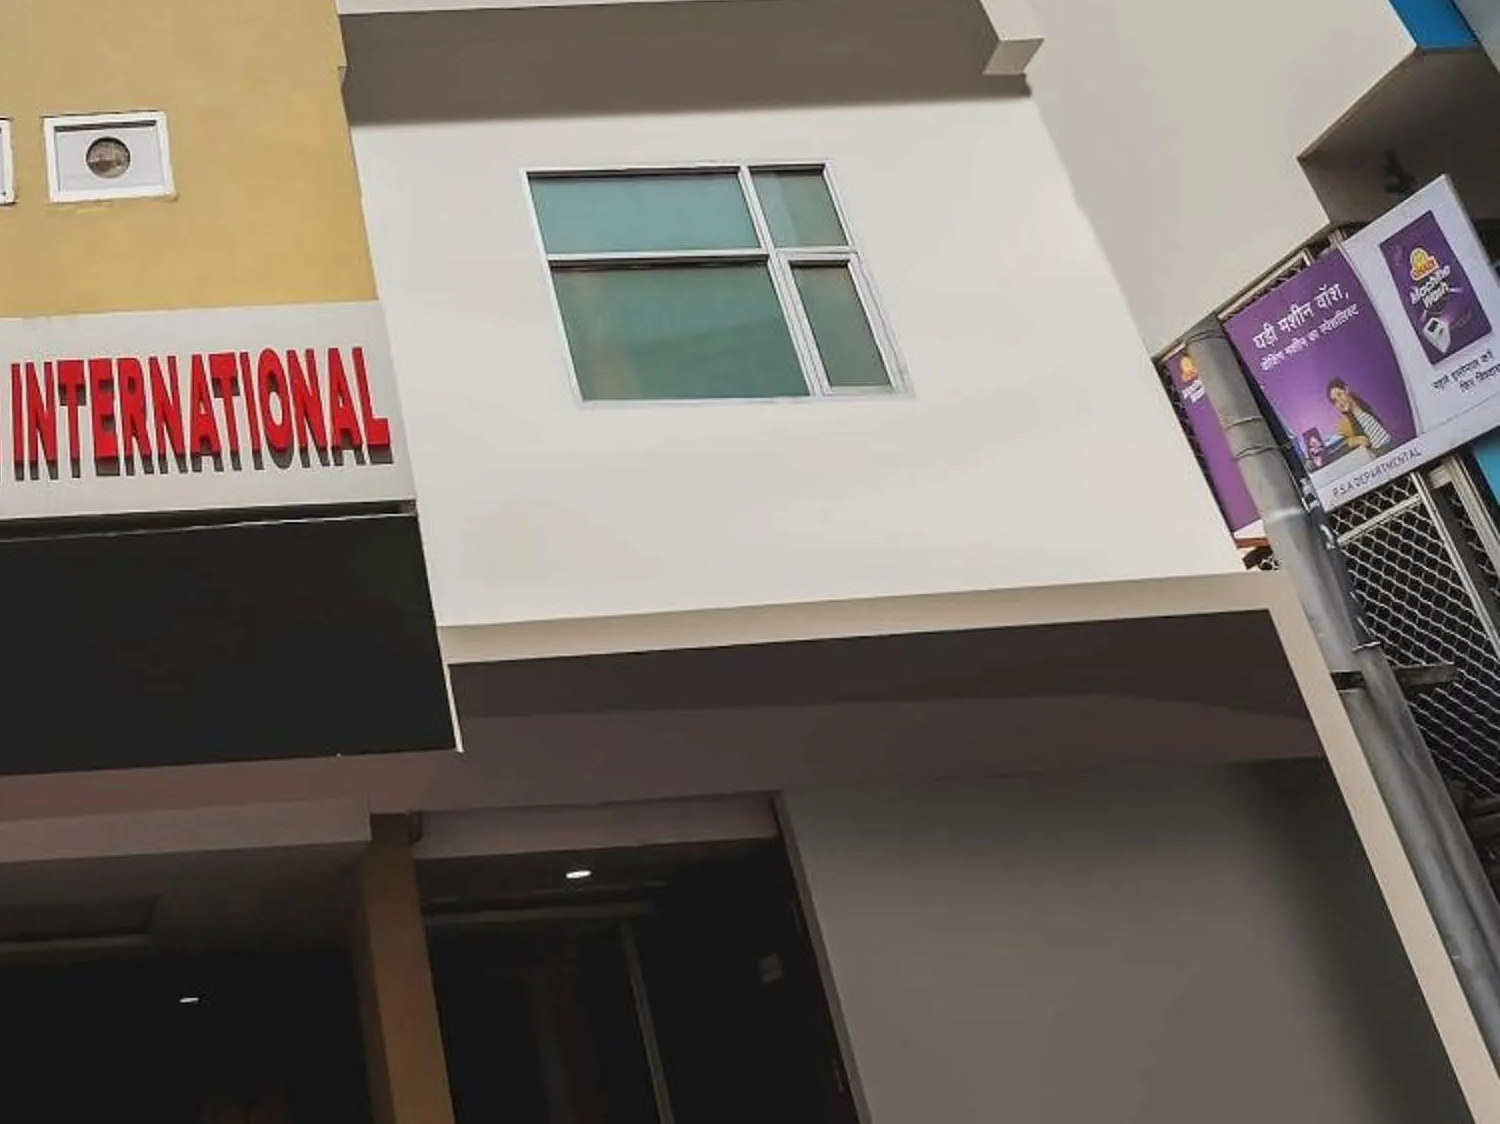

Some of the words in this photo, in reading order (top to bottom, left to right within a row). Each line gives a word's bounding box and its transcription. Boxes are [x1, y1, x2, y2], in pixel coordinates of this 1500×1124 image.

[1252, 322, 1278, 349] घड़ी
[1277, 301, 1315, 332] मशीन
[11, 347, 393, 480] INTERNATIONAL
